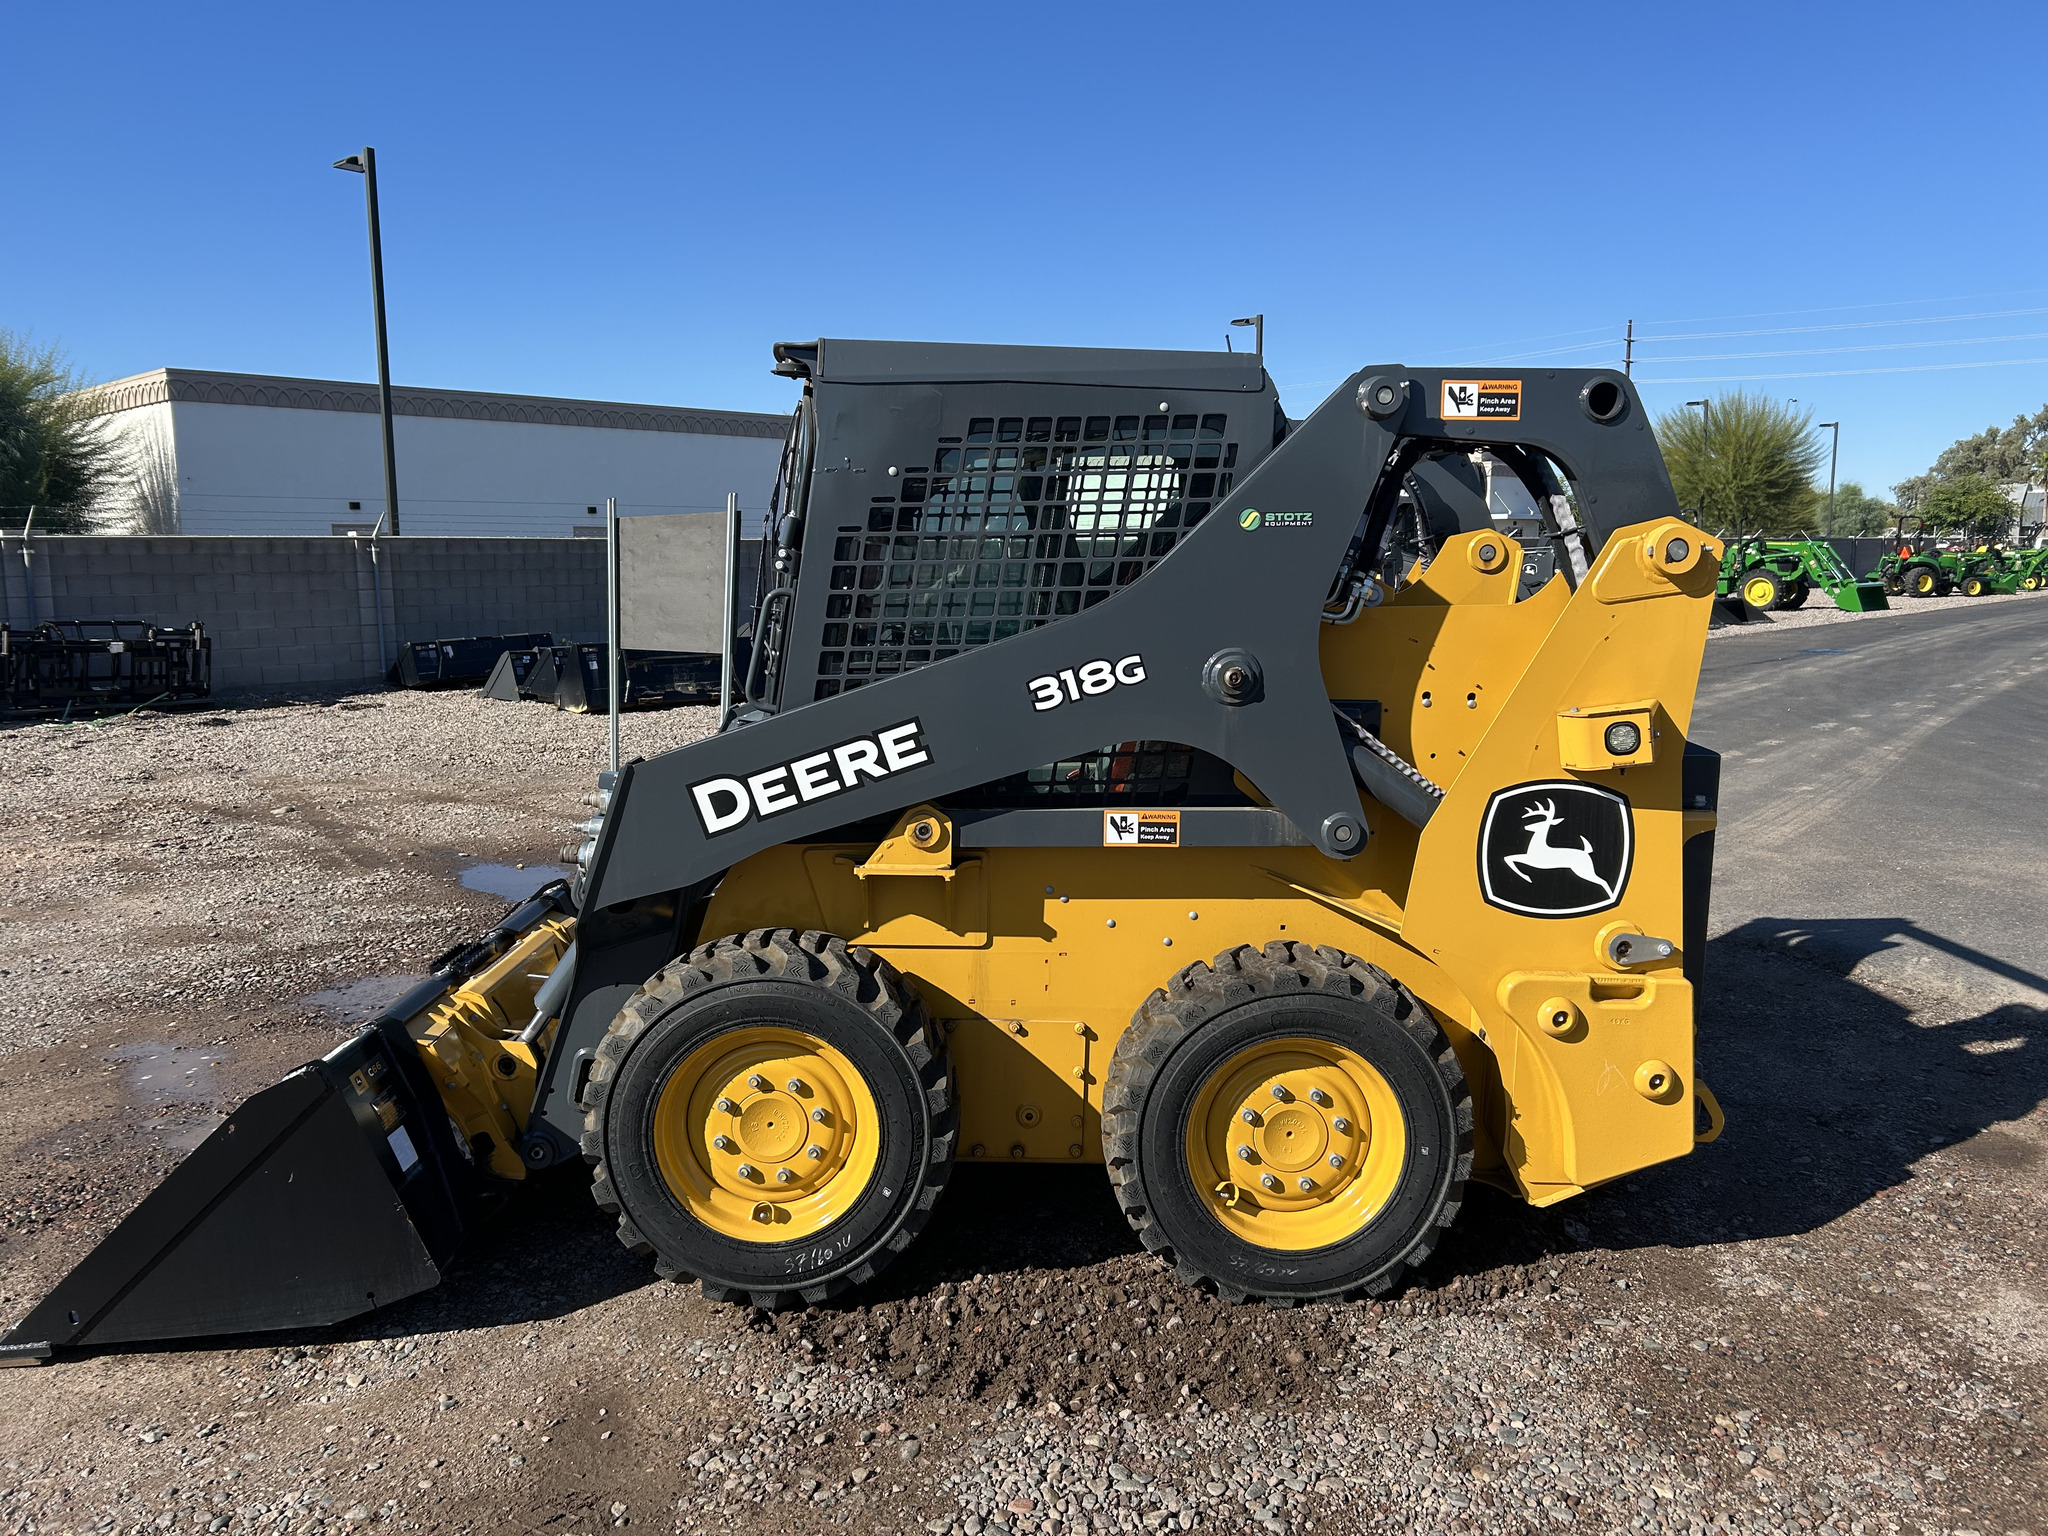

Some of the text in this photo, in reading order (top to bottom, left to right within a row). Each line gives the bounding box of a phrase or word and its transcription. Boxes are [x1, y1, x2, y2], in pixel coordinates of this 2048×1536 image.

[1265, 512, 1313, 521] STOTZ
[1028, 655, 1147, 711] 318G
[691, 722, 929, 834] DEERE
[367, 1061, 382, 1077] C66
